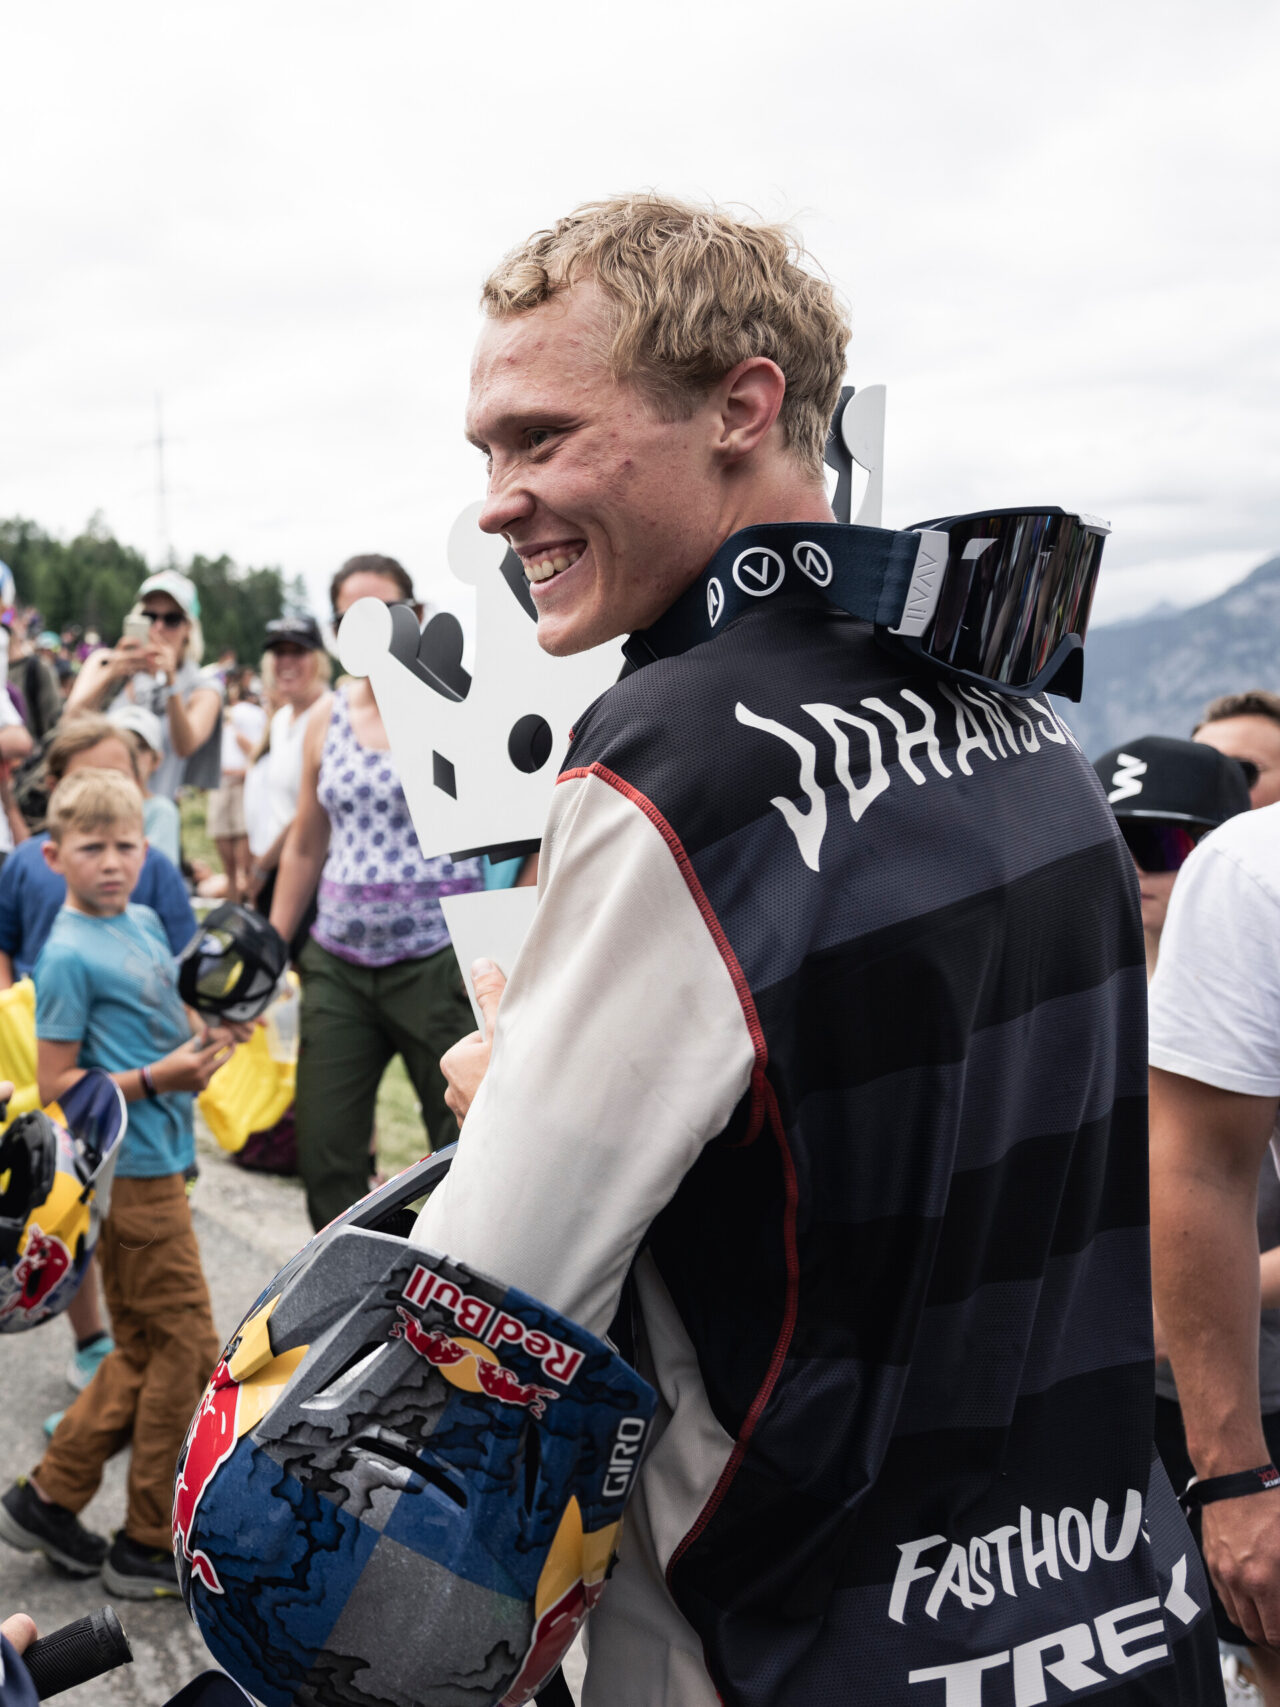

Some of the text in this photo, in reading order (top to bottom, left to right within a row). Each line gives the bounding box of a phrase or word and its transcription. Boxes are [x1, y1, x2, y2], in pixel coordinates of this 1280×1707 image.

[735, 681, 1082, 872] JOHANSS
[601, 1417, 646, 1498] GIRO
[887, 1488, 1152, 1625] FASTHOU
